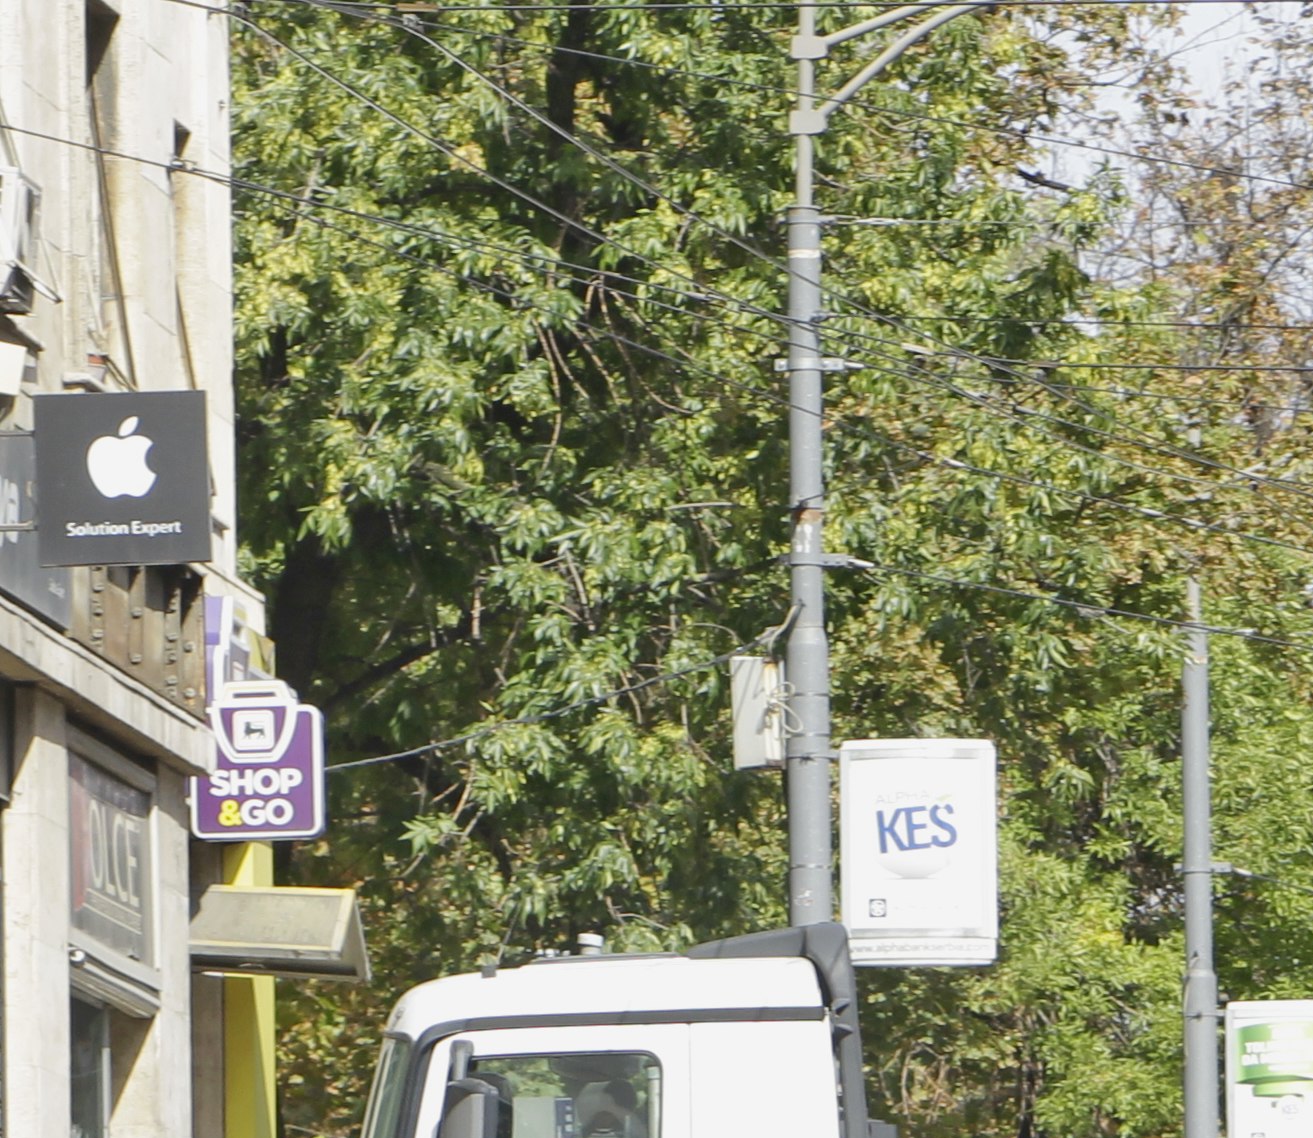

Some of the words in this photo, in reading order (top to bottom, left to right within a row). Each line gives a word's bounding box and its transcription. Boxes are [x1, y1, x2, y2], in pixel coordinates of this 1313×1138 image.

[66, 521, 129, 537] Solution
[131, 520, 182, 537] Expert
[209, 767, 302, 797] SHOP
[217, 797, 294, 827] &GO
